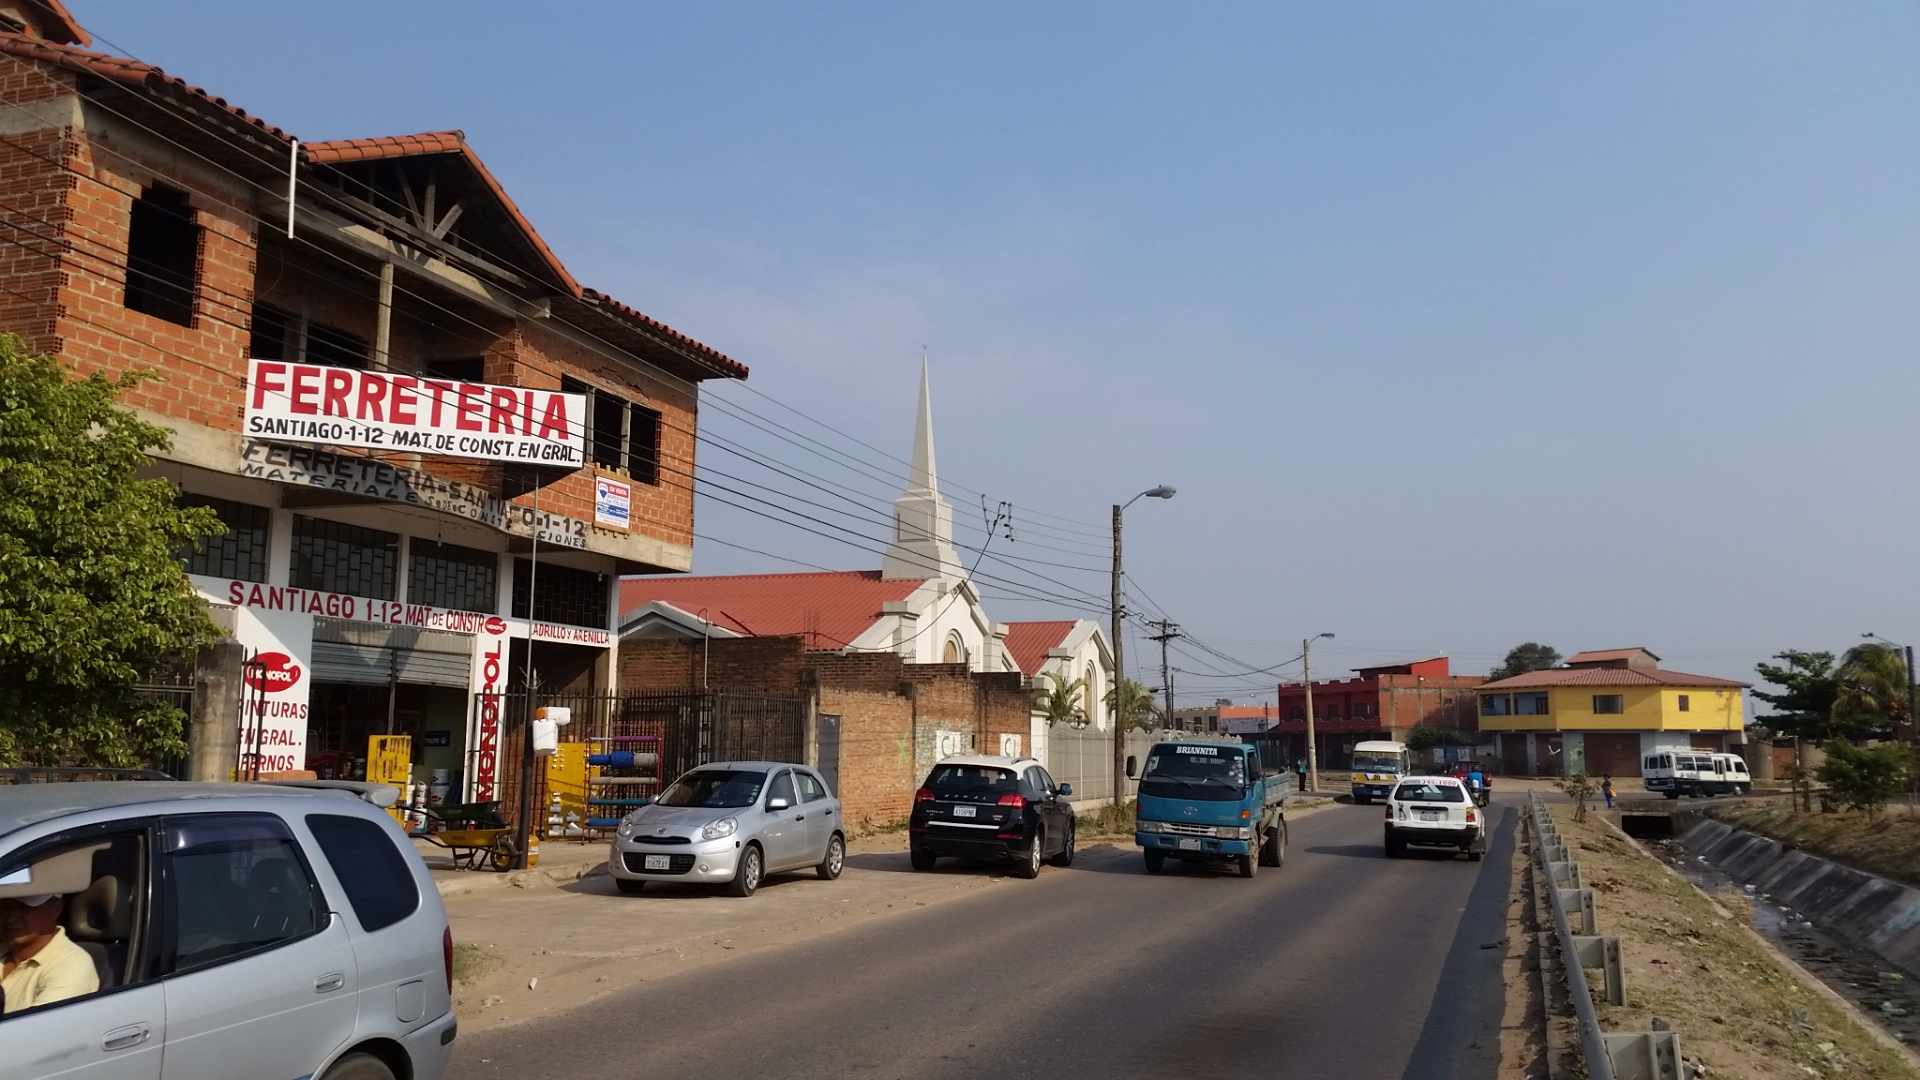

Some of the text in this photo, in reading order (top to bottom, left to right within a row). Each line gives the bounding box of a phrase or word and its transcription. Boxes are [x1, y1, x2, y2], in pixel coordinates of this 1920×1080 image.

[252, 362, 569, 440] FERRETERIA
[436, 434, 455, 450] DE
[459, 437, 515, 457] CONST.
[518, 442, 539, 459] EN
[541, 444, 581, 463] GRAL.
[229, 581, 355, 619] SANTIAGO
[366, 599, 403, 624] 1-12
[405, 605, 432, 627] MAT
[432, 613, 445, 626] DE
[573, 629, 609, 645] ARENILLA
